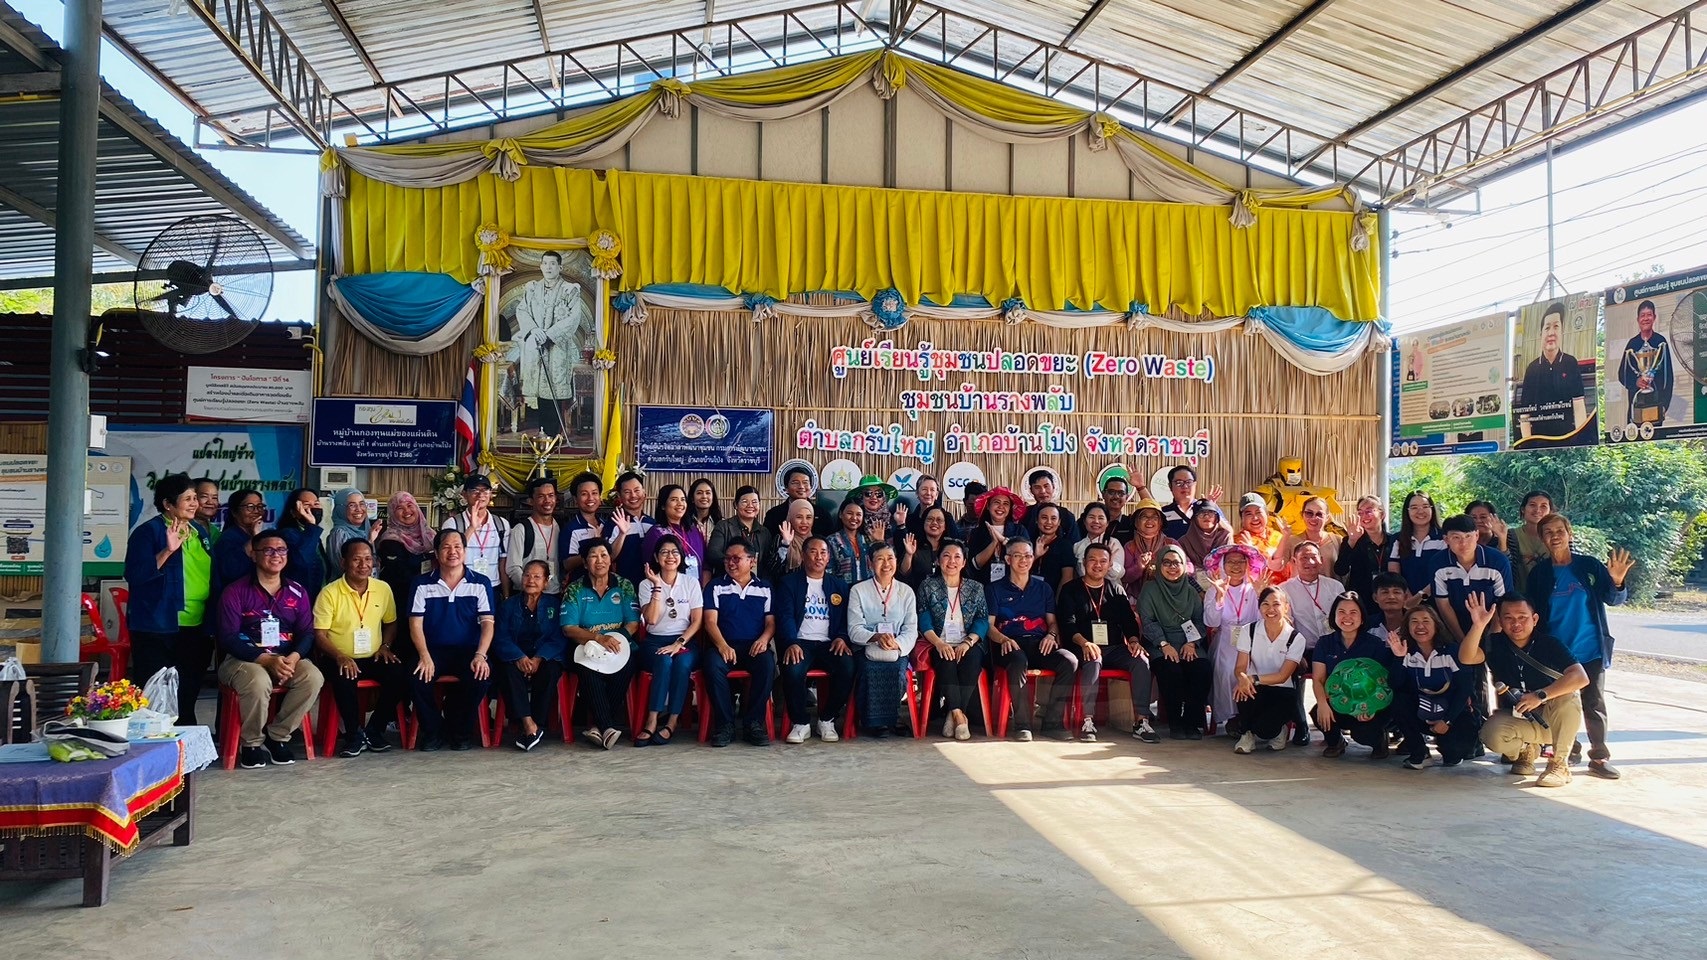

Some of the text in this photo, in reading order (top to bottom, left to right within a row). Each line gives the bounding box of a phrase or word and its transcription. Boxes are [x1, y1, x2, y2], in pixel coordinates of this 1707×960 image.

[833, 340, 1212, 381] ศูนย์เรียนรู้ชุมชนปลอดขยะ (Zero Waste)
[902, 385, 1072, 418] ชุมชนบ้านรางพลับ
[333, 428, 437, 439] หมู่บ้านกองทุนแม่ของแผ่นดิน
[800, 422, 1208, 465] ตำบลกรับใหญ่ อำเภอบ้านโป่ง จังหวัดราชบุรี
[192, 437, 255, 462] แปลงใหญ่ข้าว
[948, 478, 978, 488] SCG
